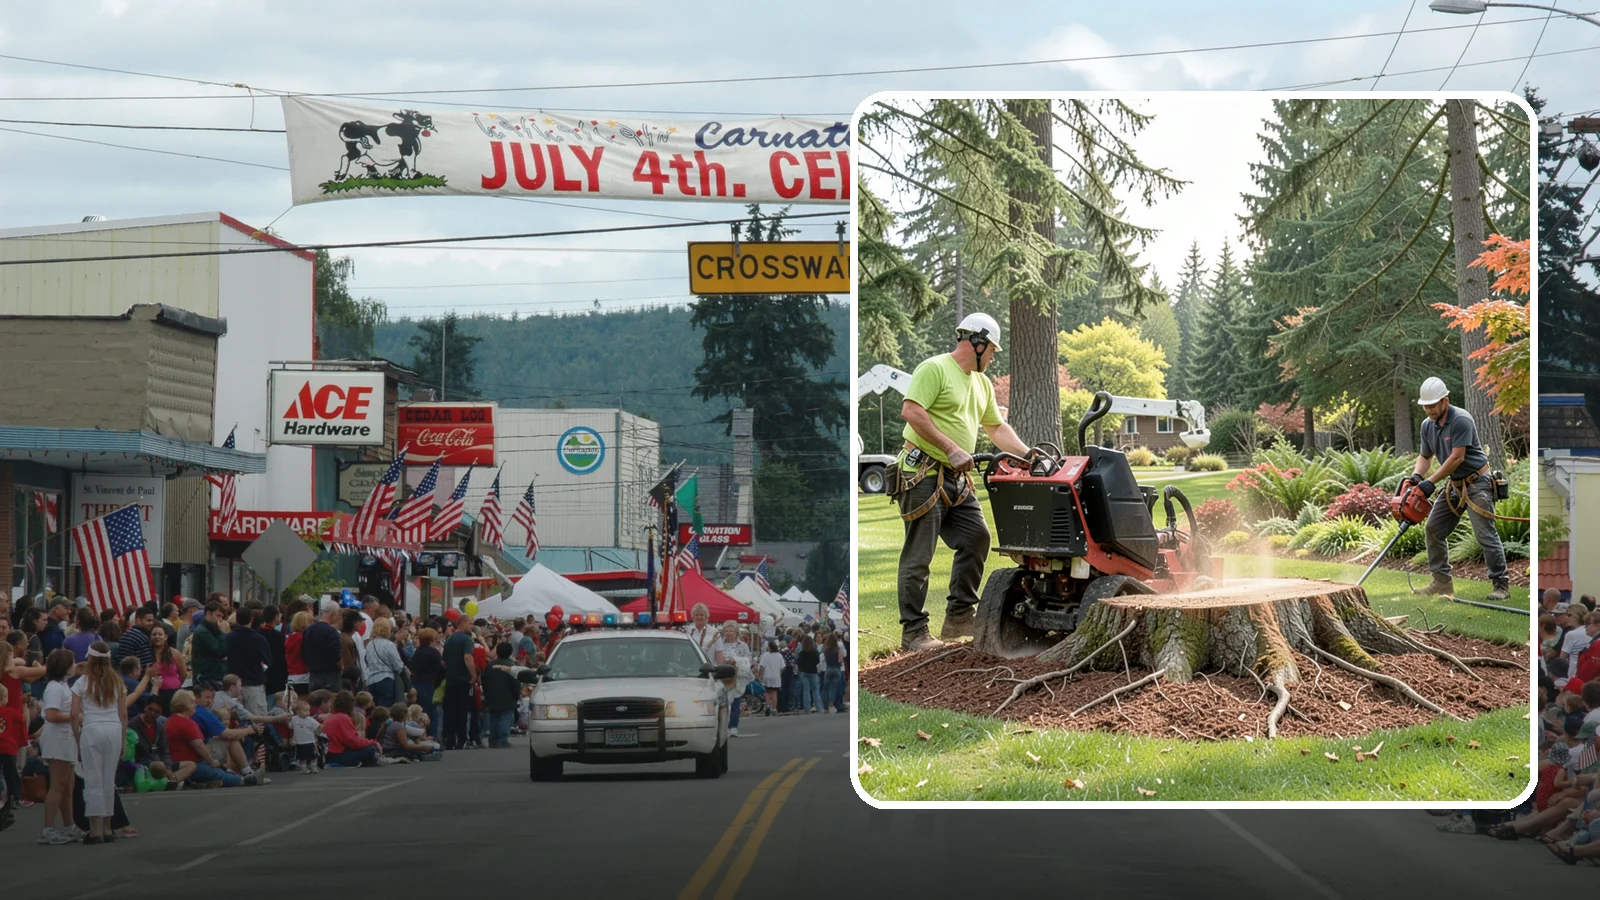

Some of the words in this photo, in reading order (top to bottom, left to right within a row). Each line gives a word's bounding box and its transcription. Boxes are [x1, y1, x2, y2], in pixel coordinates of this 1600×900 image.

[481, 141, 605, 193] JULY
[632, 150, 747, 198] 4th.
[697, 254, 850, 280] CROSSWA
[283, 380, 373, 420] ACE
[406, 409, 452, 422] CEDAR
[461, 409, 485, 422] LOG
[284, 421, 370, 436] Hardware
[95, 484, 124, 495] Vincent
[126, 485, 136, 495] de
[138, 485, 155, 495] Paul
[699, 535, 730, 543] GLASS
